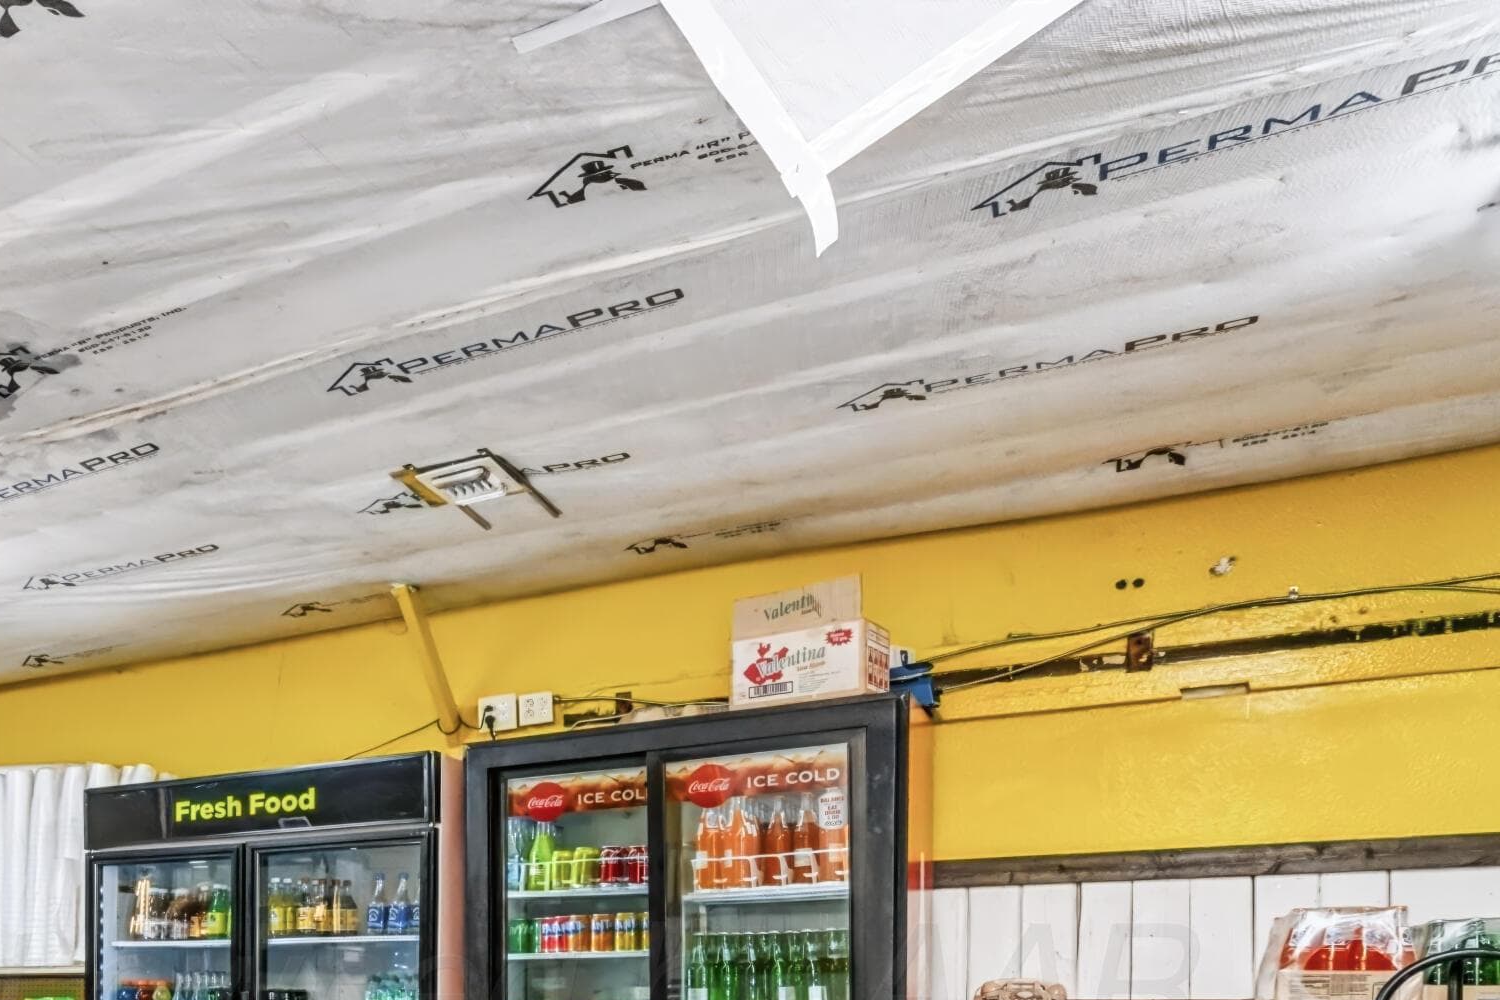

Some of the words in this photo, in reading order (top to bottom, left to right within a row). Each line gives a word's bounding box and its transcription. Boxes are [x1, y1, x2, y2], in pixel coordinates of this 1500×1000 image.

[397, 288, 685, 375] PERMAPRO
[924, 315, 1258, 394] PERMAPRO
[62, 543, 220, 582] PERMAPRO
[577, 791, 605, 805] ICE
[610, 788, 647, 801] COL
[747, 774, 779, 789] ICE
[786, 767, 840, 785] COLD
[174, 796, 242, 823] Fresh
[248, 787, 317, 816] Food
